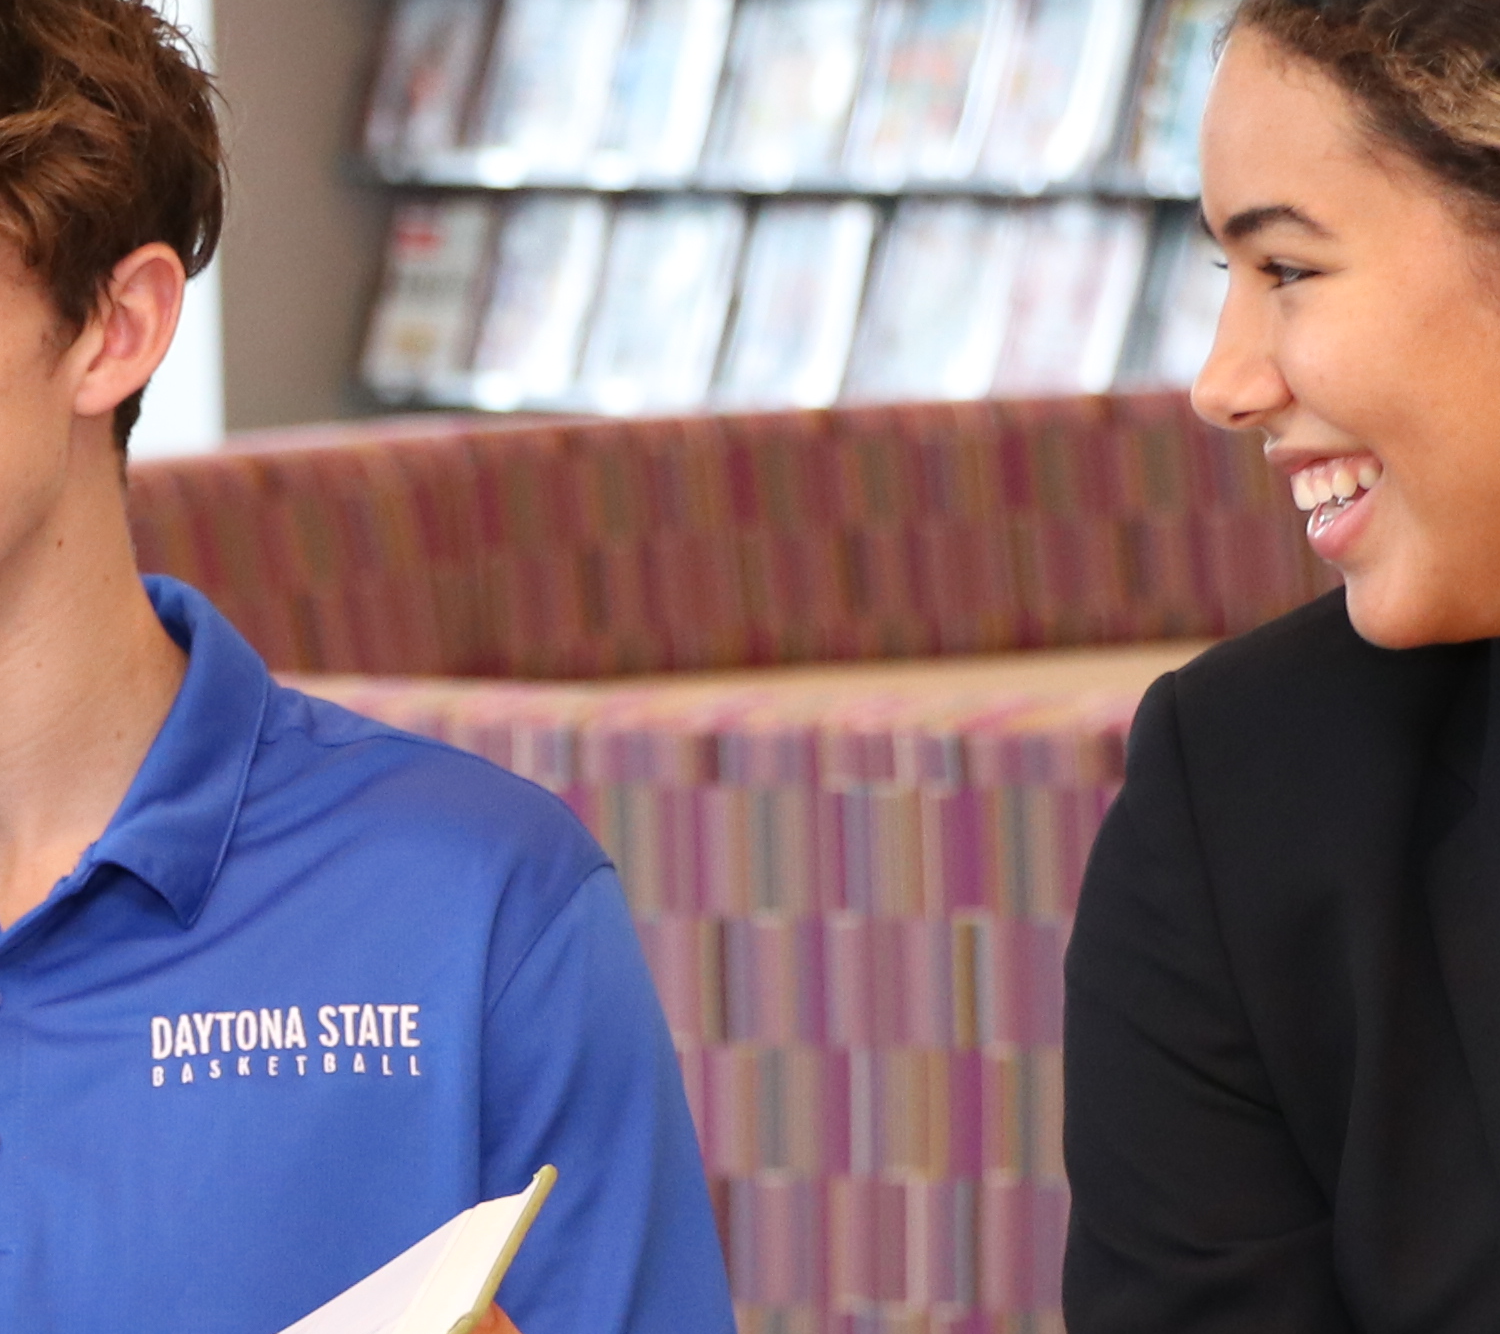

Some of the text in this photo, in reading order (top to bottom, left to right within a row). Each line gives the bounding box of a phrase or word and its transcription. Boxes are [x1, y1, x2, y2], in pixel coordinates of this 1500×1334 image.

[150, 1003, 421, 1061] DAYTONA STATE
[151, 1051, 421, 1088] BASKETBALL
